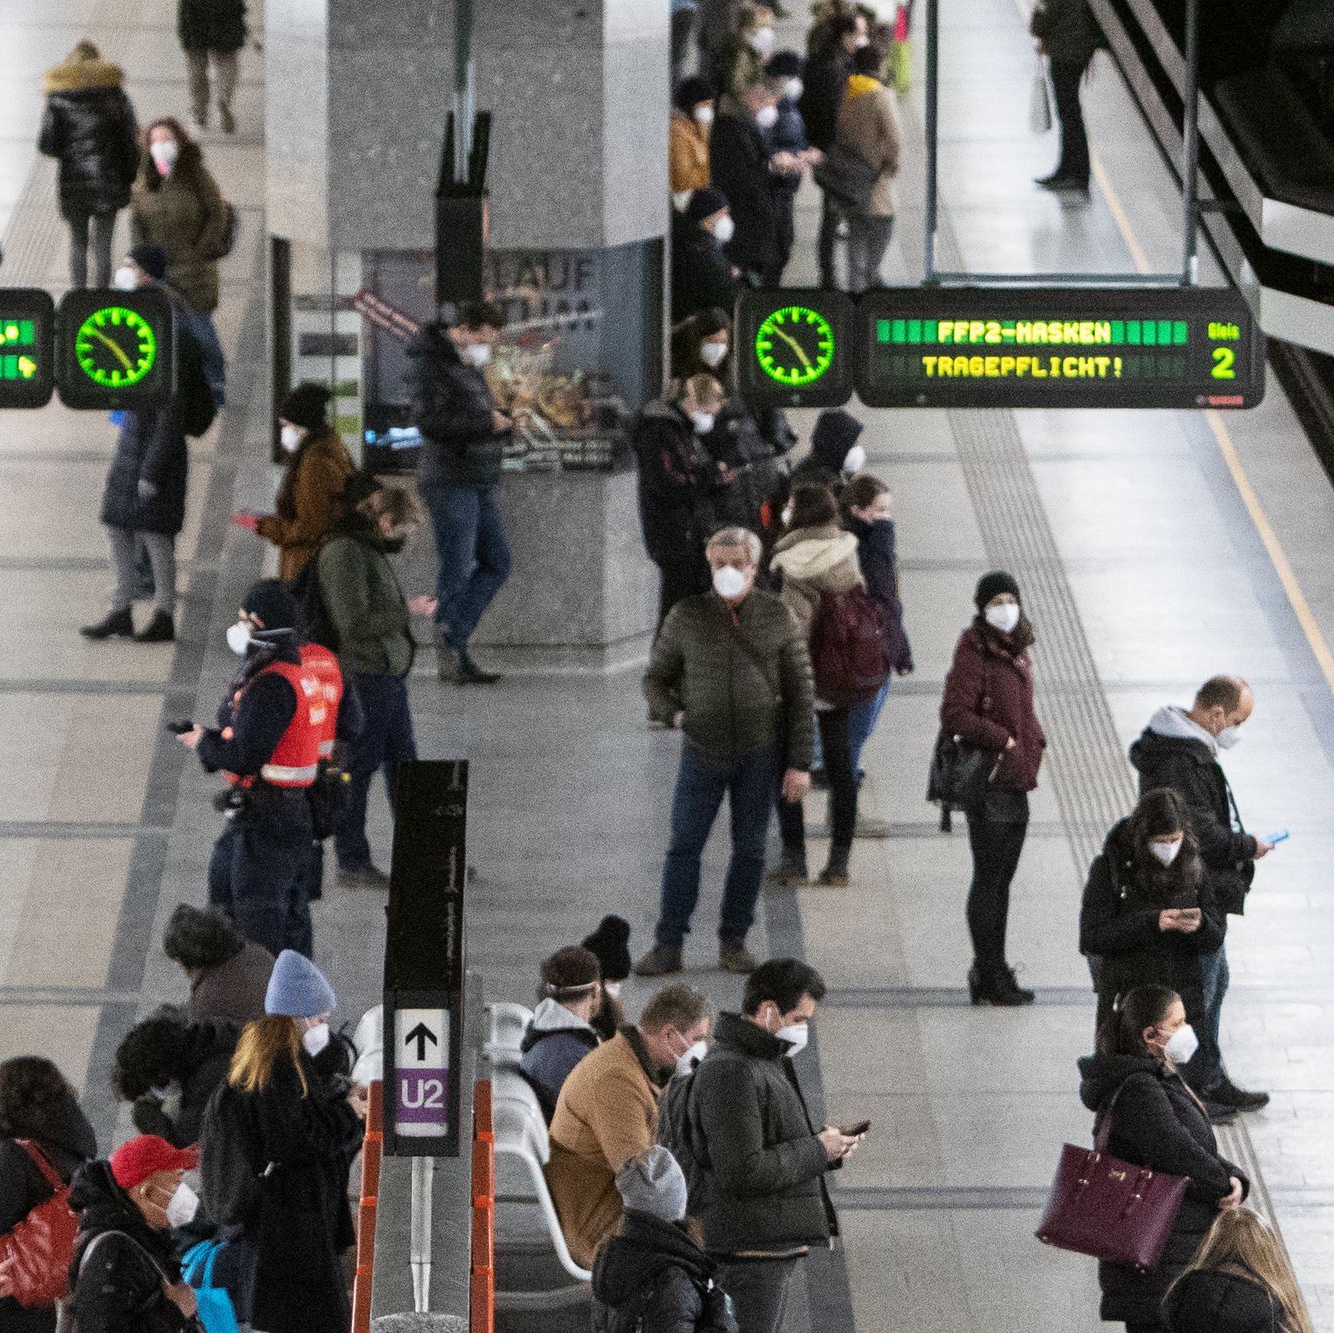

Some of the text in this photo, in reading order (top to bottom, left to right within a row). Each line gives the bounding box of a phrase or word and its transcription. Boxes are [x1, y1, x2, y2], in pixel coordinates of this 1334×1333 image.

[937, 320, 1111, 344] FFP2-MASKEN
[1208, 322, 1240, 340] Gleis
[922, 356, 1123, 378] TRAGEPFLICHT!
[1211, 347, 1236, 379] 2
[402, 1079, 444, 1108] U2
